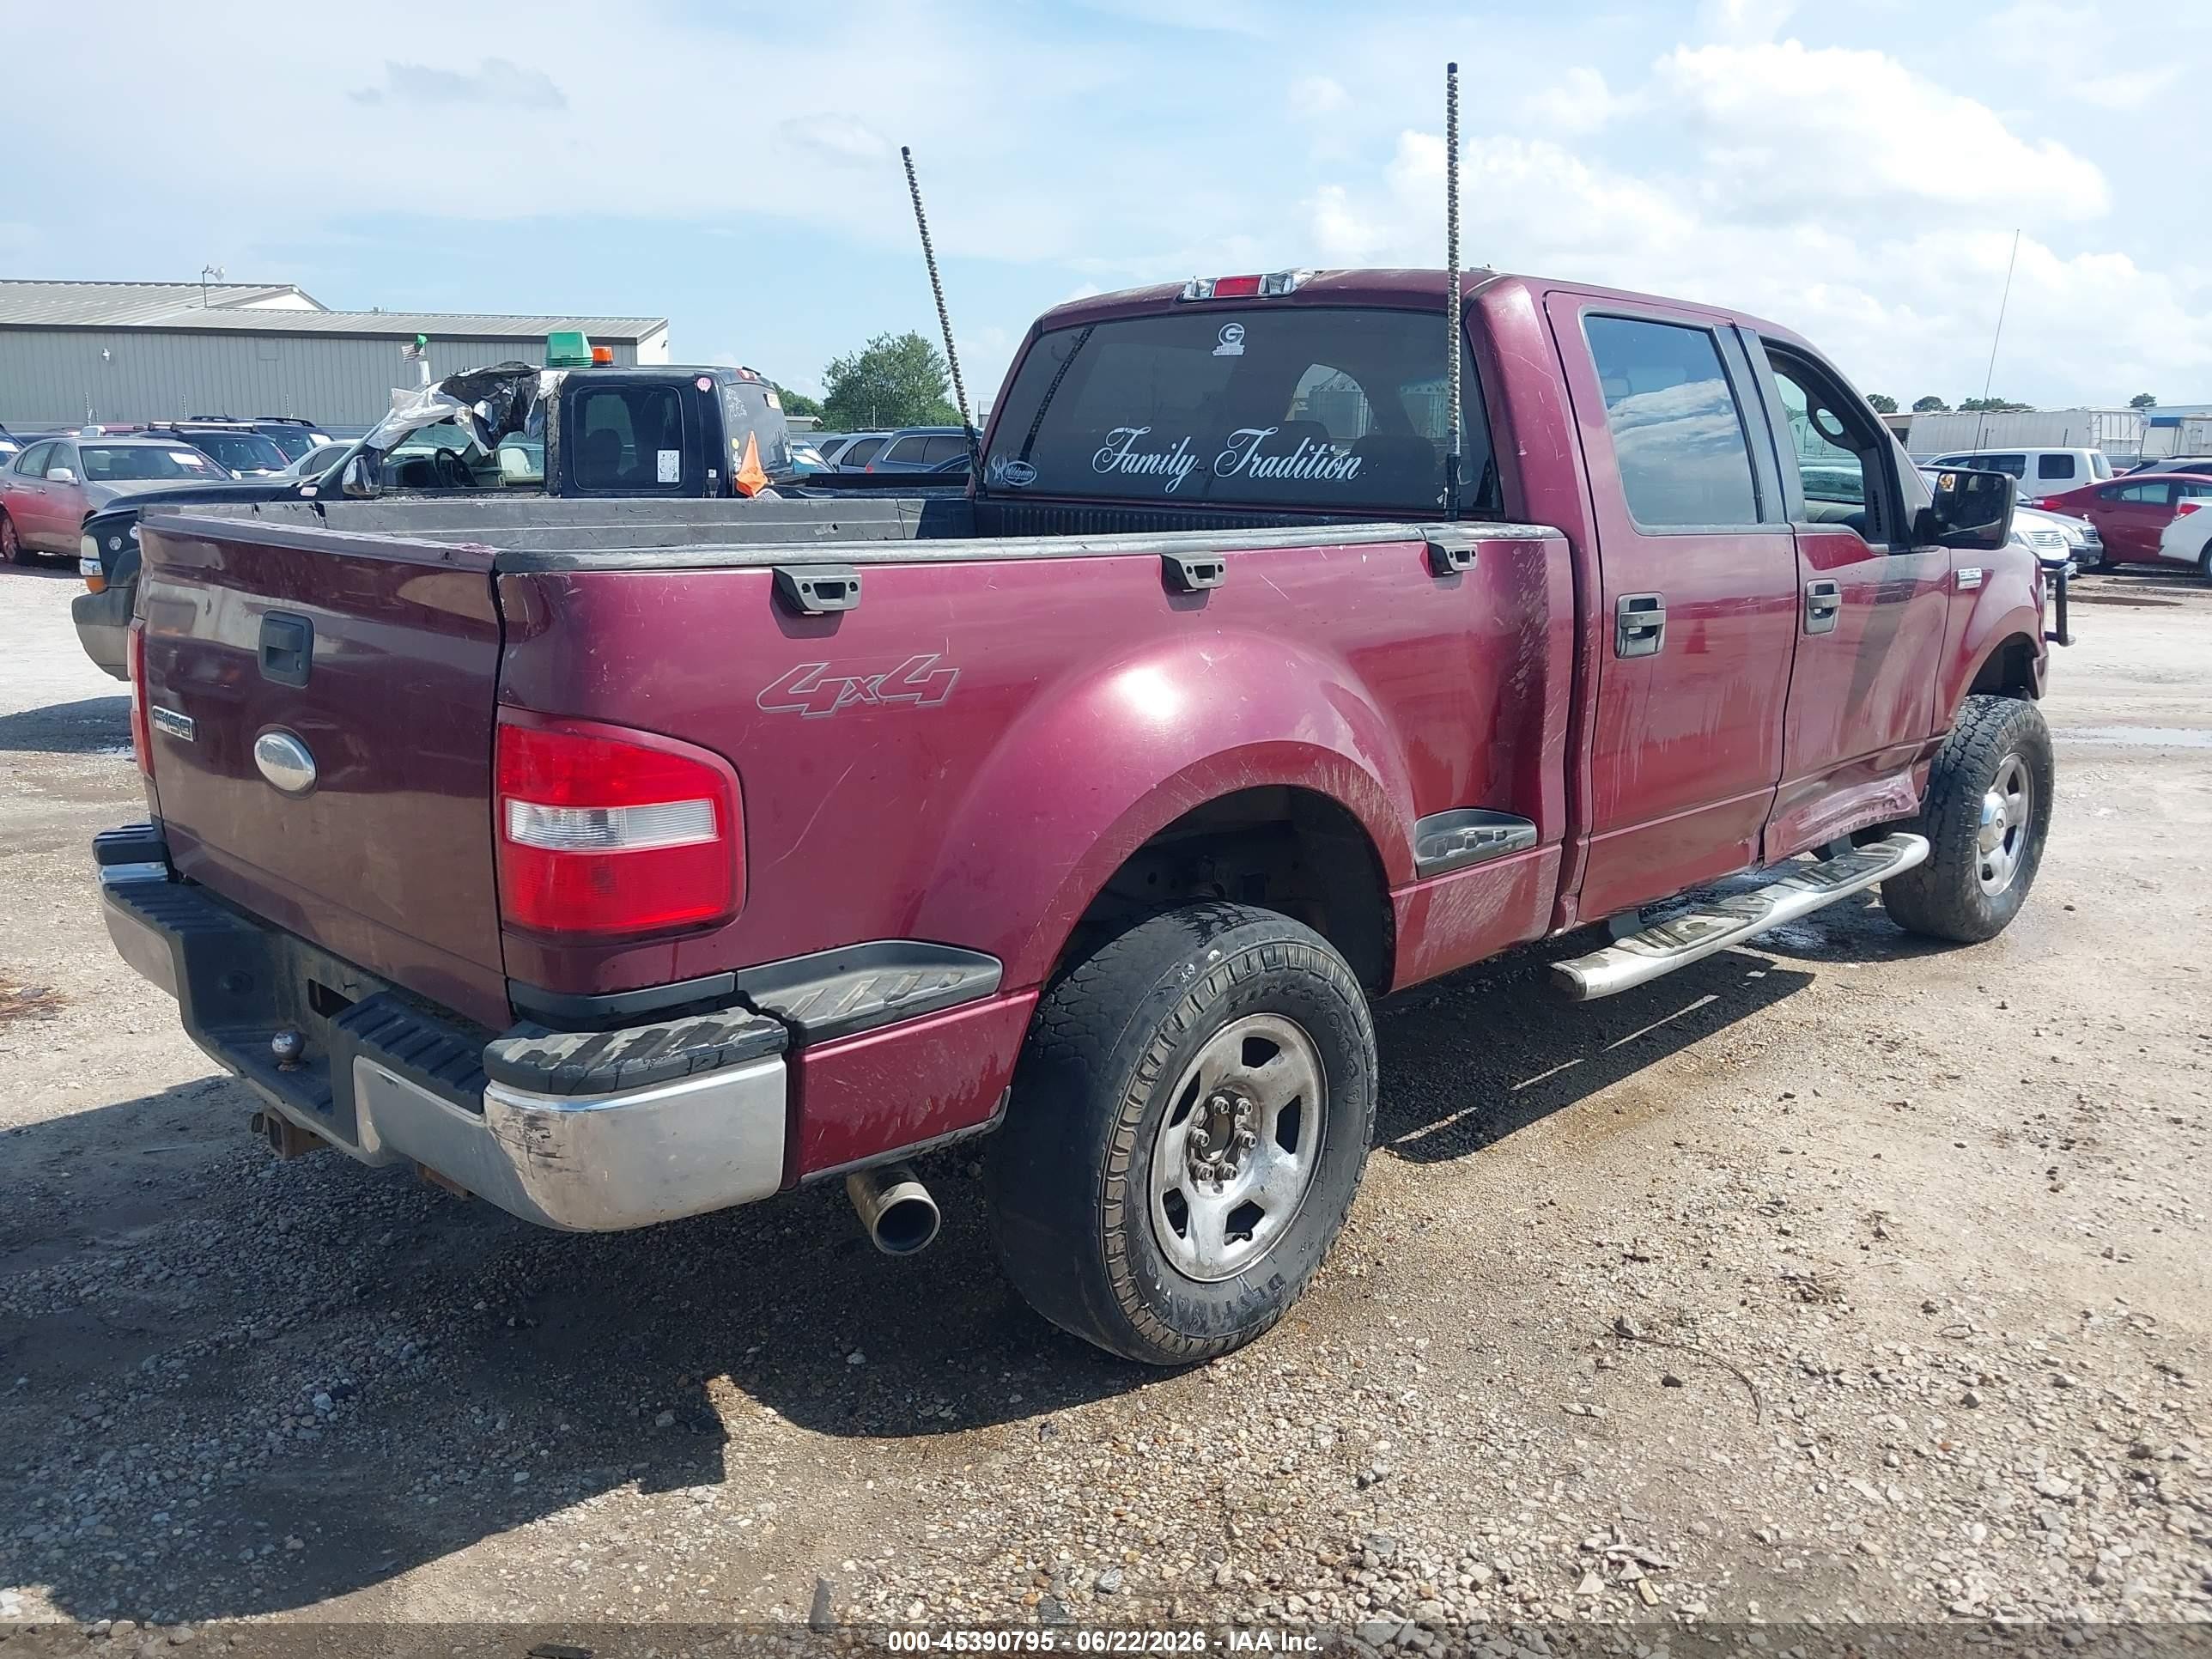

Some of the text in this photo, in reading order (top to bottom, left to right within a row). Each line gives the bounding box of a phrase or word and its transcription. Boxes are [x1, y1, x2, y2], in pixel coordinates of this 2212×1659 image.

[1092, 426, 1362, 493] Family Tradition
[756, 653, 960, 719] 4x4
